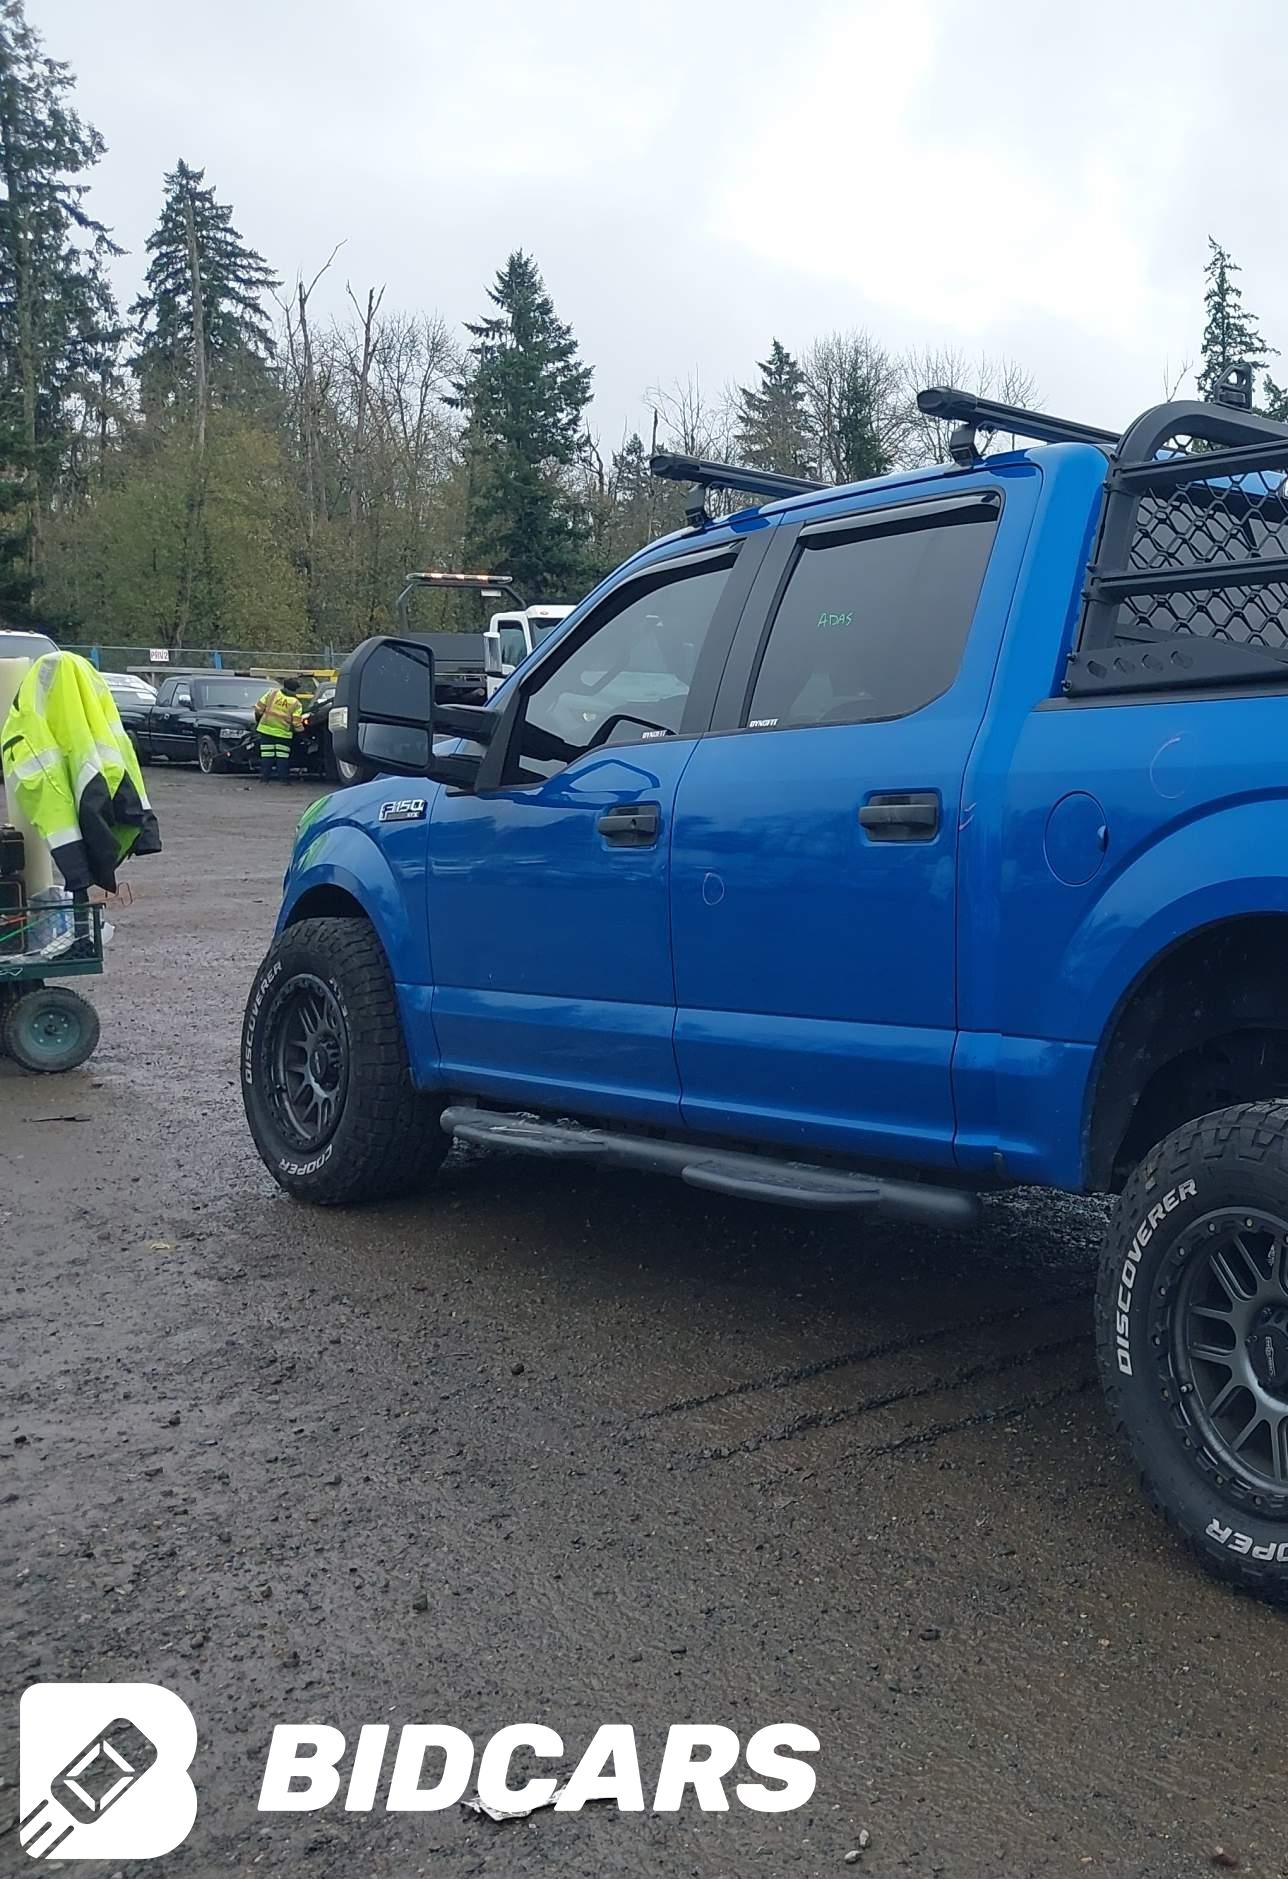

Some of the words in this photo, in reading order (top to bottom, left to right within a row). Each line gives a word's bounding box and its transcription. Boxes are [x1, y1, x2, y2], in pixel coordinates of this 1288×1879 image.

[817, 611, 852, 627] ADAS
[245, 961, 283, 1084] DISCOVERER
[278, 1144, 333, 1176] COOPER
[1113, 1178, 1198, 1377] DISCOVERER
